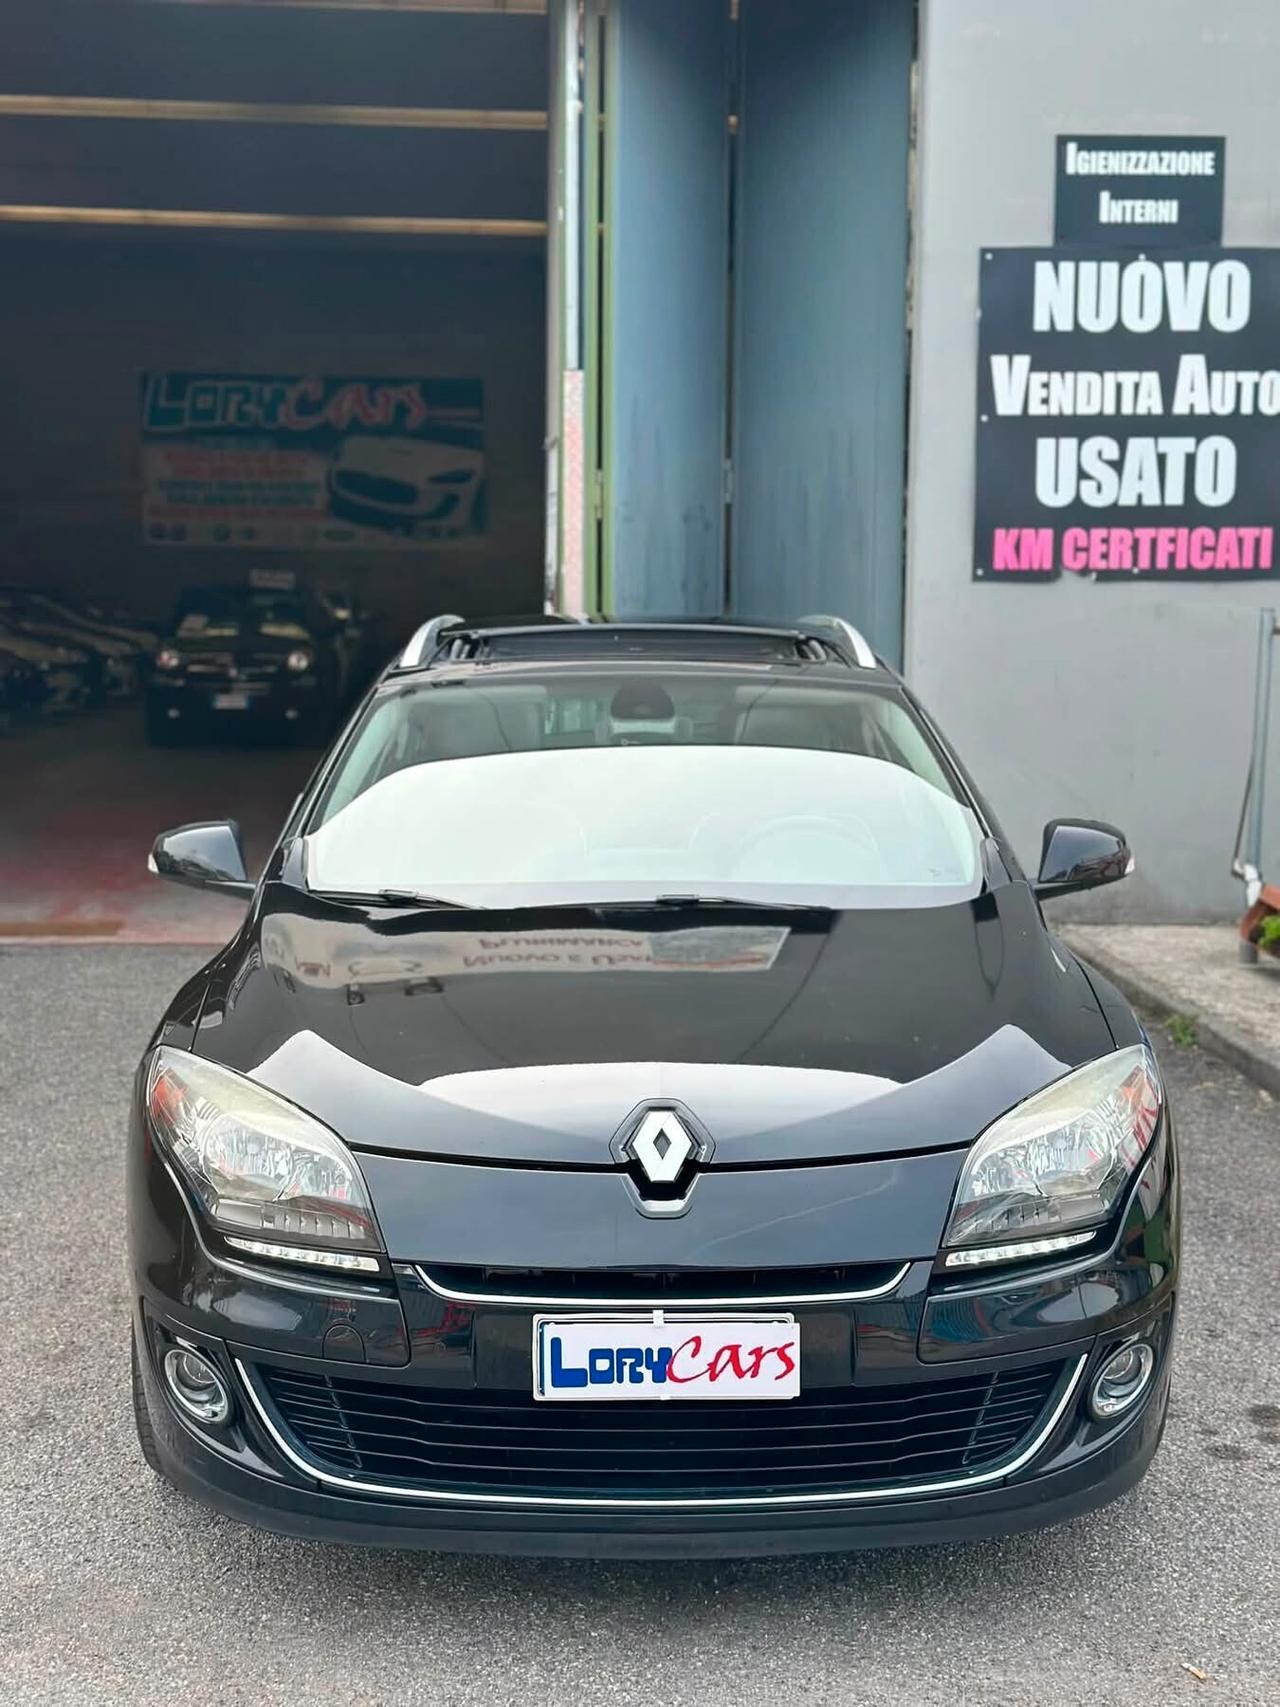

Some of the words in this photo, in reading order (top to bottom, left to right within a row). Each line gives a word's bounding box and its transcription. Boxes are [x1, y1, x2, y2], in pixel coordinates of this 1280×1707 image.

[1066, 142, 1216, 175] IGIENIZZAZIONE
[1099, 191, 1179, 223] INTERNI
[1033, 260, 1251, 332] NUOVO
[990, 354, 1163, 416] VENDITA
[1172, 353, 1280, 416] AUTO
[1035, 435, 1237, 507] USATO
[993, 527, 1054, 570] KM
[1061, 526, 1273, 571] CERTFICATI
